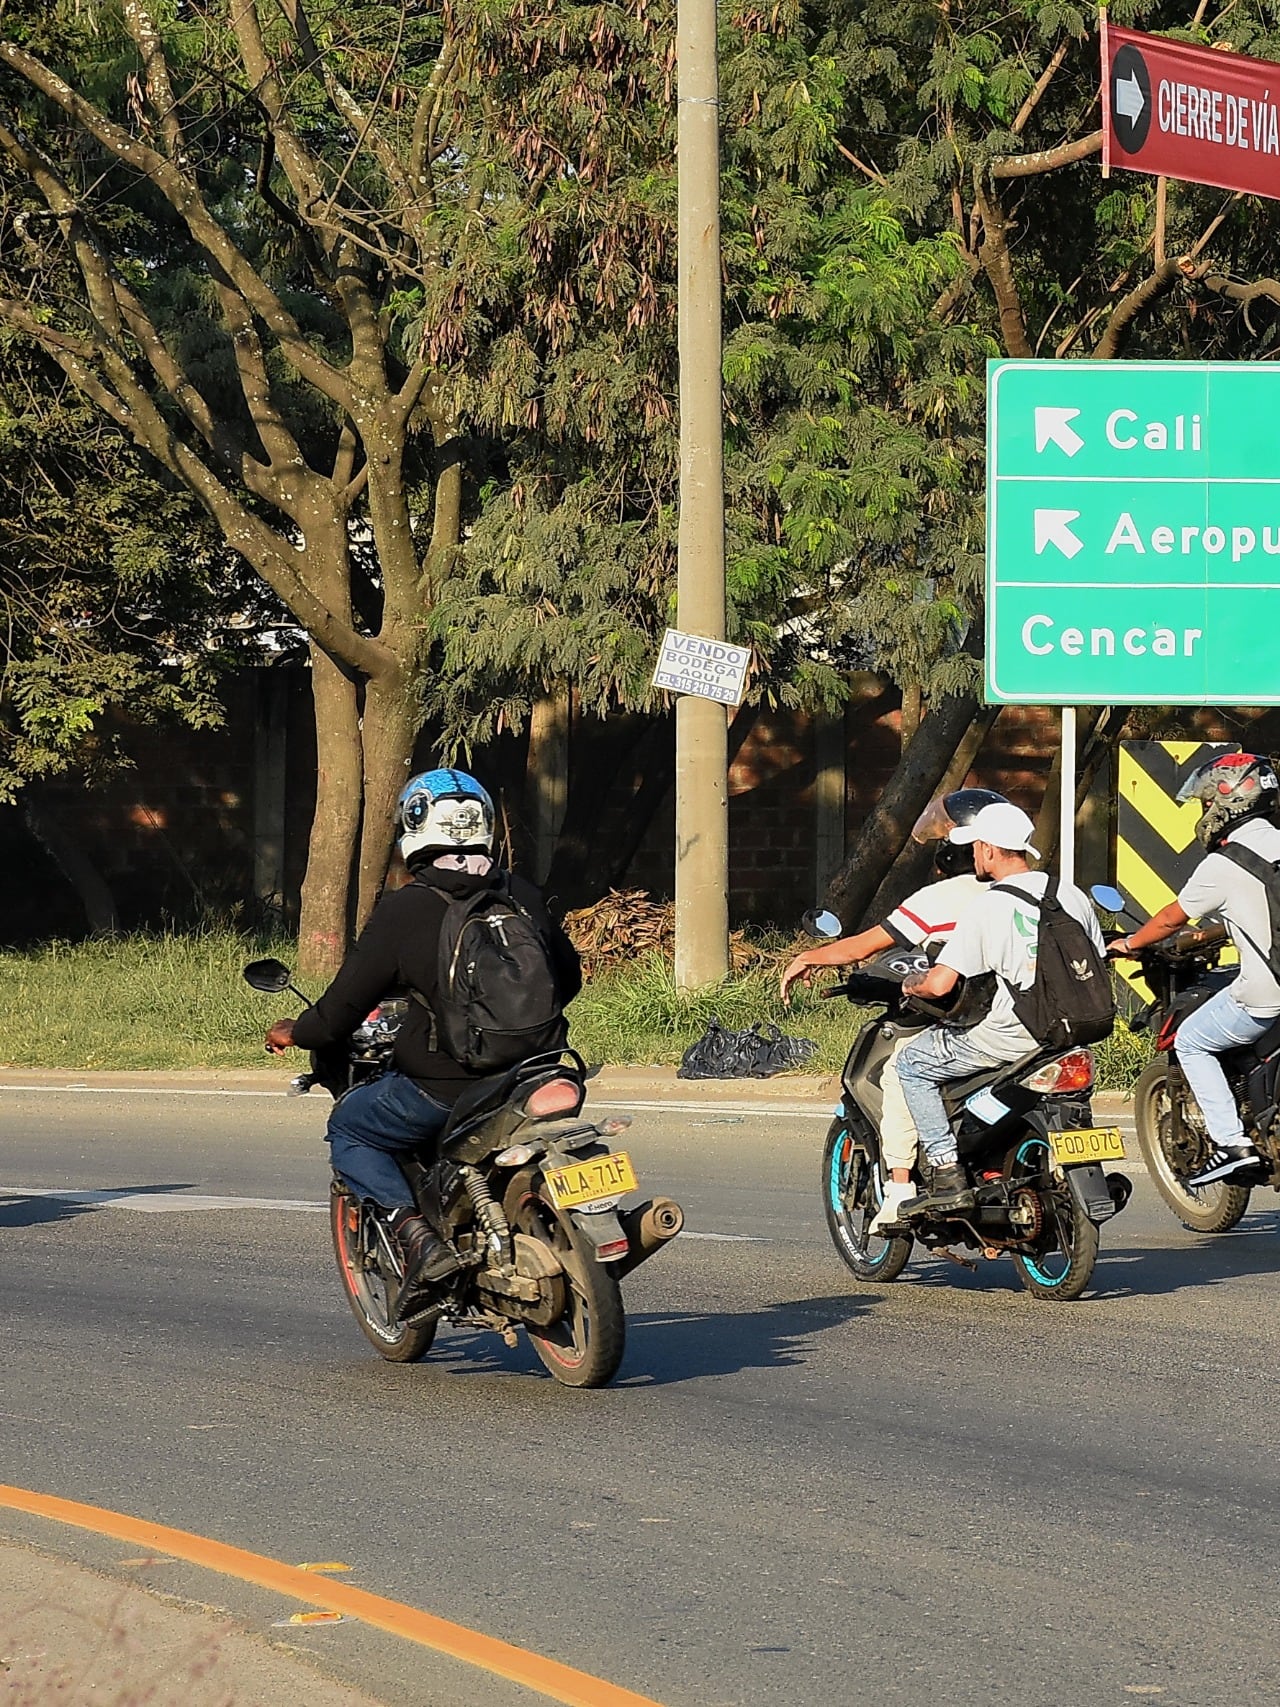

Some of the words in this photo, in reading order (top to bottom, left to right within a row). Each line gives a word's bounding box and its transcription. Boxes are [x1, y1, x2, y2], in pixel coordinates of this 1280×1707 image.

[1158, 78, 1223, 144] CIERRE
[1226, 94, 1249, 150] DE
[1251, 89, 1280, 156] VÍA
[1105, 408, 1202, 451] Cali
[673, 635, 741, 664] VENDO
[1021, 614, 1203, 657] Cencar
[665, 651, 738, 679] BODEGA
[674, 677, 692, 691] 315
[692, 681, 709, 695] 218
[710, 685, 723, 698] 75
[723, 689, 735, 701] 29
[1089, 1132, 1119, 1152] 07C
[552, 1171, 591, 1198] MLA
[592, 1159, 625, 1187] 71F
